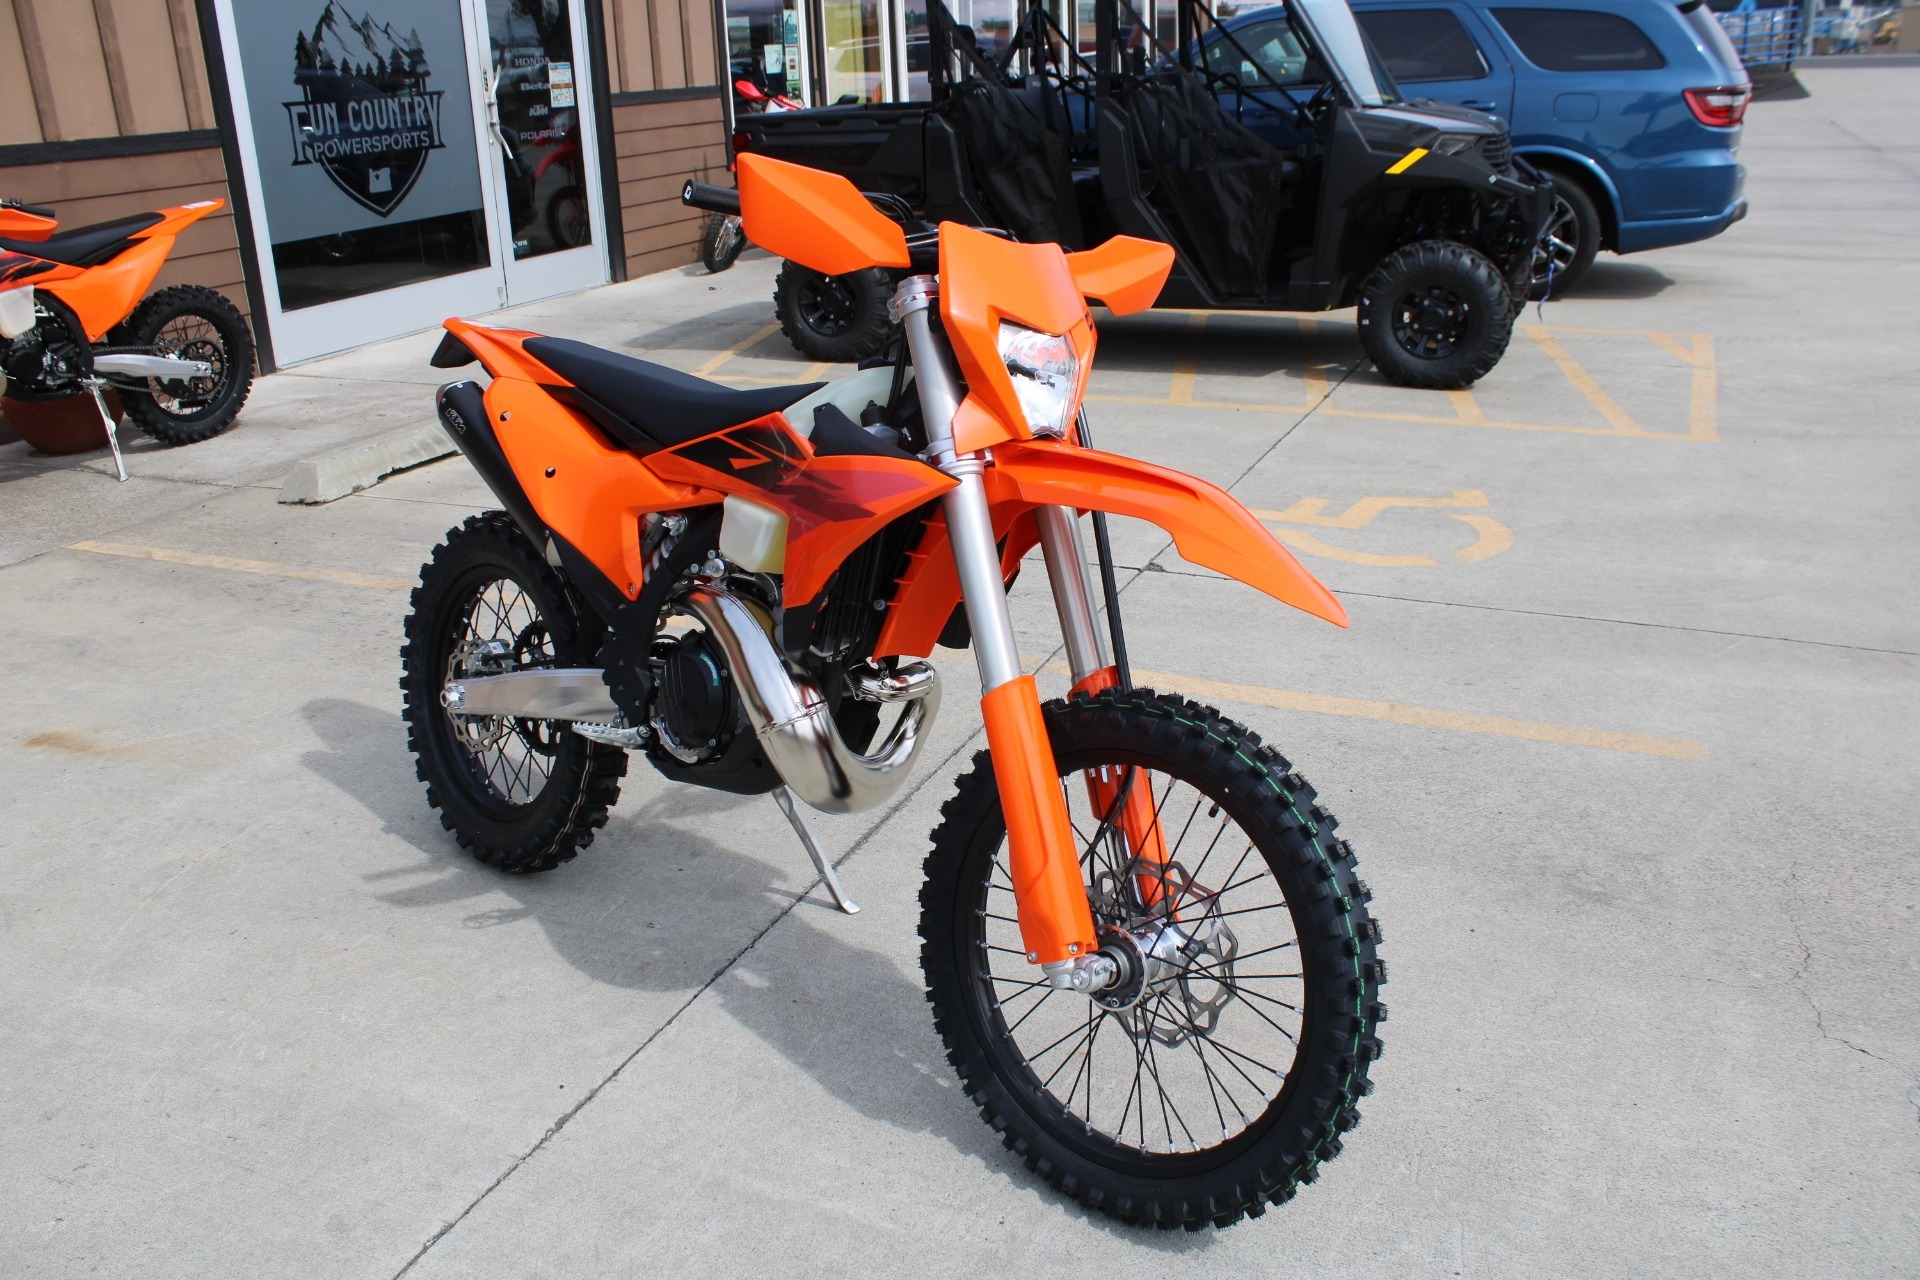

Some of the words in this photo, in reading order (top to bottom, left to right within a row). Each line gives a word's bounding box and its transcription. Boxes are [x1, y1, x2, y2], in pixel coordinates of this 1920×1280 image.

[514, 57, 551, 66] HONDA
[520, 83, 550, 91] Beta
[529, 104, 549, 117] KTM
[289, 101, 340, 163] FUN
[348, 94, 441, 145] COUNTRY
[520, 128, 562, 141] POLARIS
[313, 130, 430, 159] POWERSPORTS
[445, 408, 466, 435] KTM
